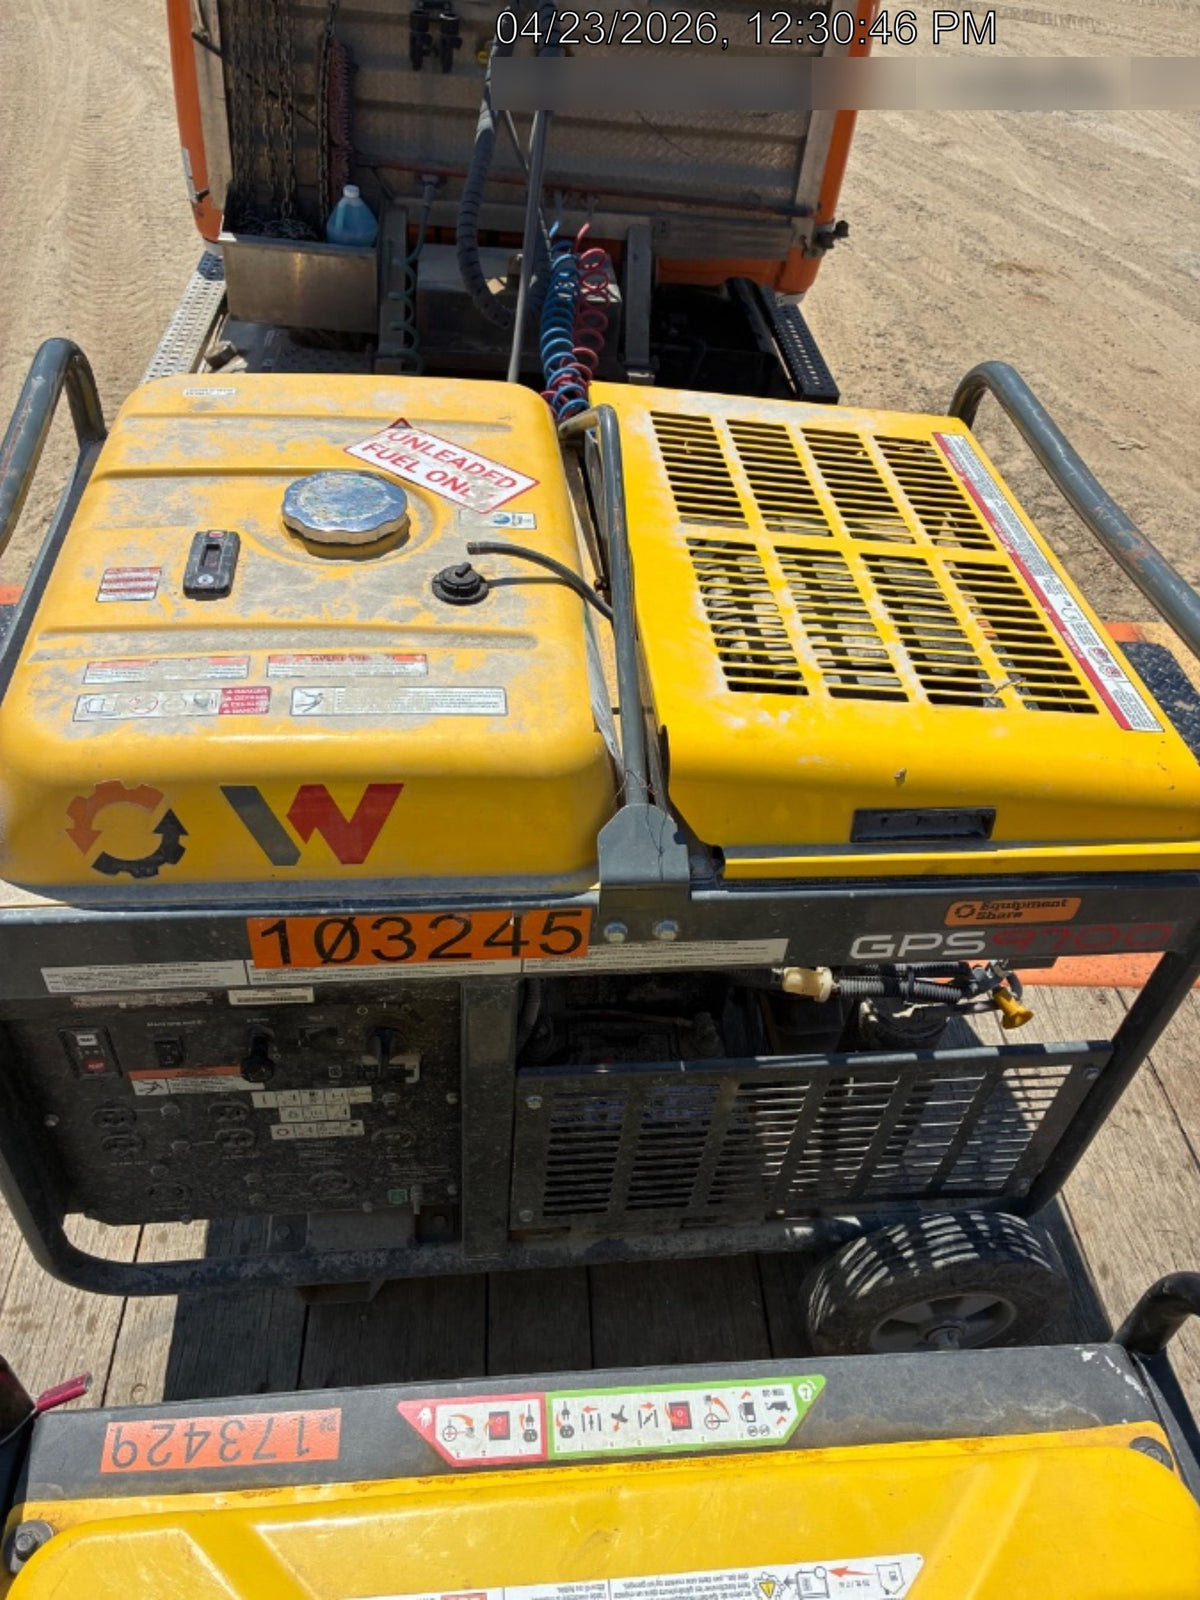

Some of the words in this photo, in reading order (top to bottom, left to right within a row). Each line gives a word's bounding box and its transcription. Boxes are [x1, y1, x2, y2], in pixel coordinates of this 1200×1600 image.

[361, 441, 418, 474] FUEL
[388, 431, 518, 489] UNLEADED
[975, 911, 1023, 921] Share
[981, 899, 1068, 911] Equipment
[260, 909, 583, 965] 103245
[849, 930, 986, 960] GPS
[991, 922, 1174, 951] 9700
[110, 1415, 311, 1468] 173429
